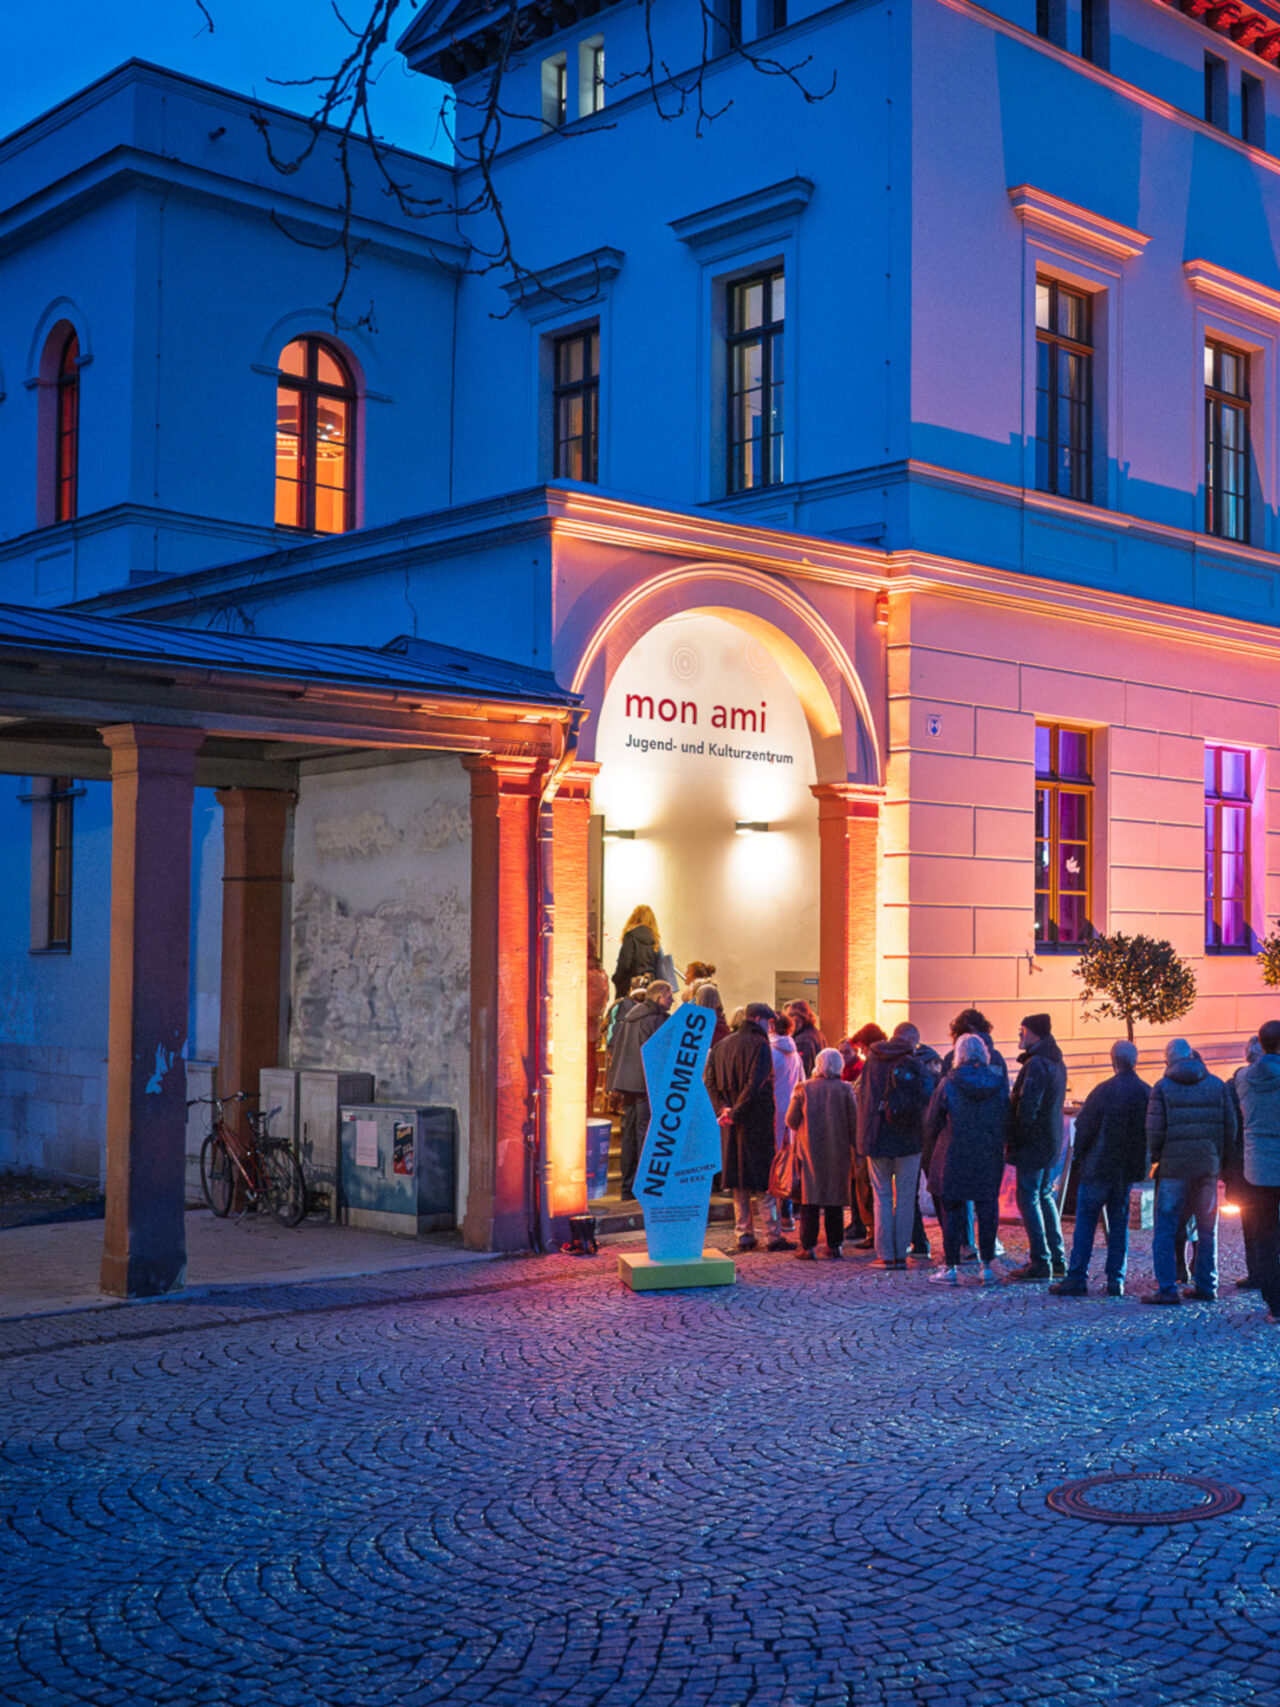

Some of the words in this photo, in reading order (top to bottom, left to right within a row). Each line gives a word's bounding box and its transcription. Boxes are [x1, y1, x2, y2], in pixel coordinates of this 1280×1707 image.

[625, 693, 697, 725] mon
[711, 701, 767, 733] ami
[625, 734, 677, 752] Jugend-
[681, 742, 704, 755] und
[709, 743, 794, 764] Kulturzentrum
[643, 1013, 706, 1197] NEWCOMERS
